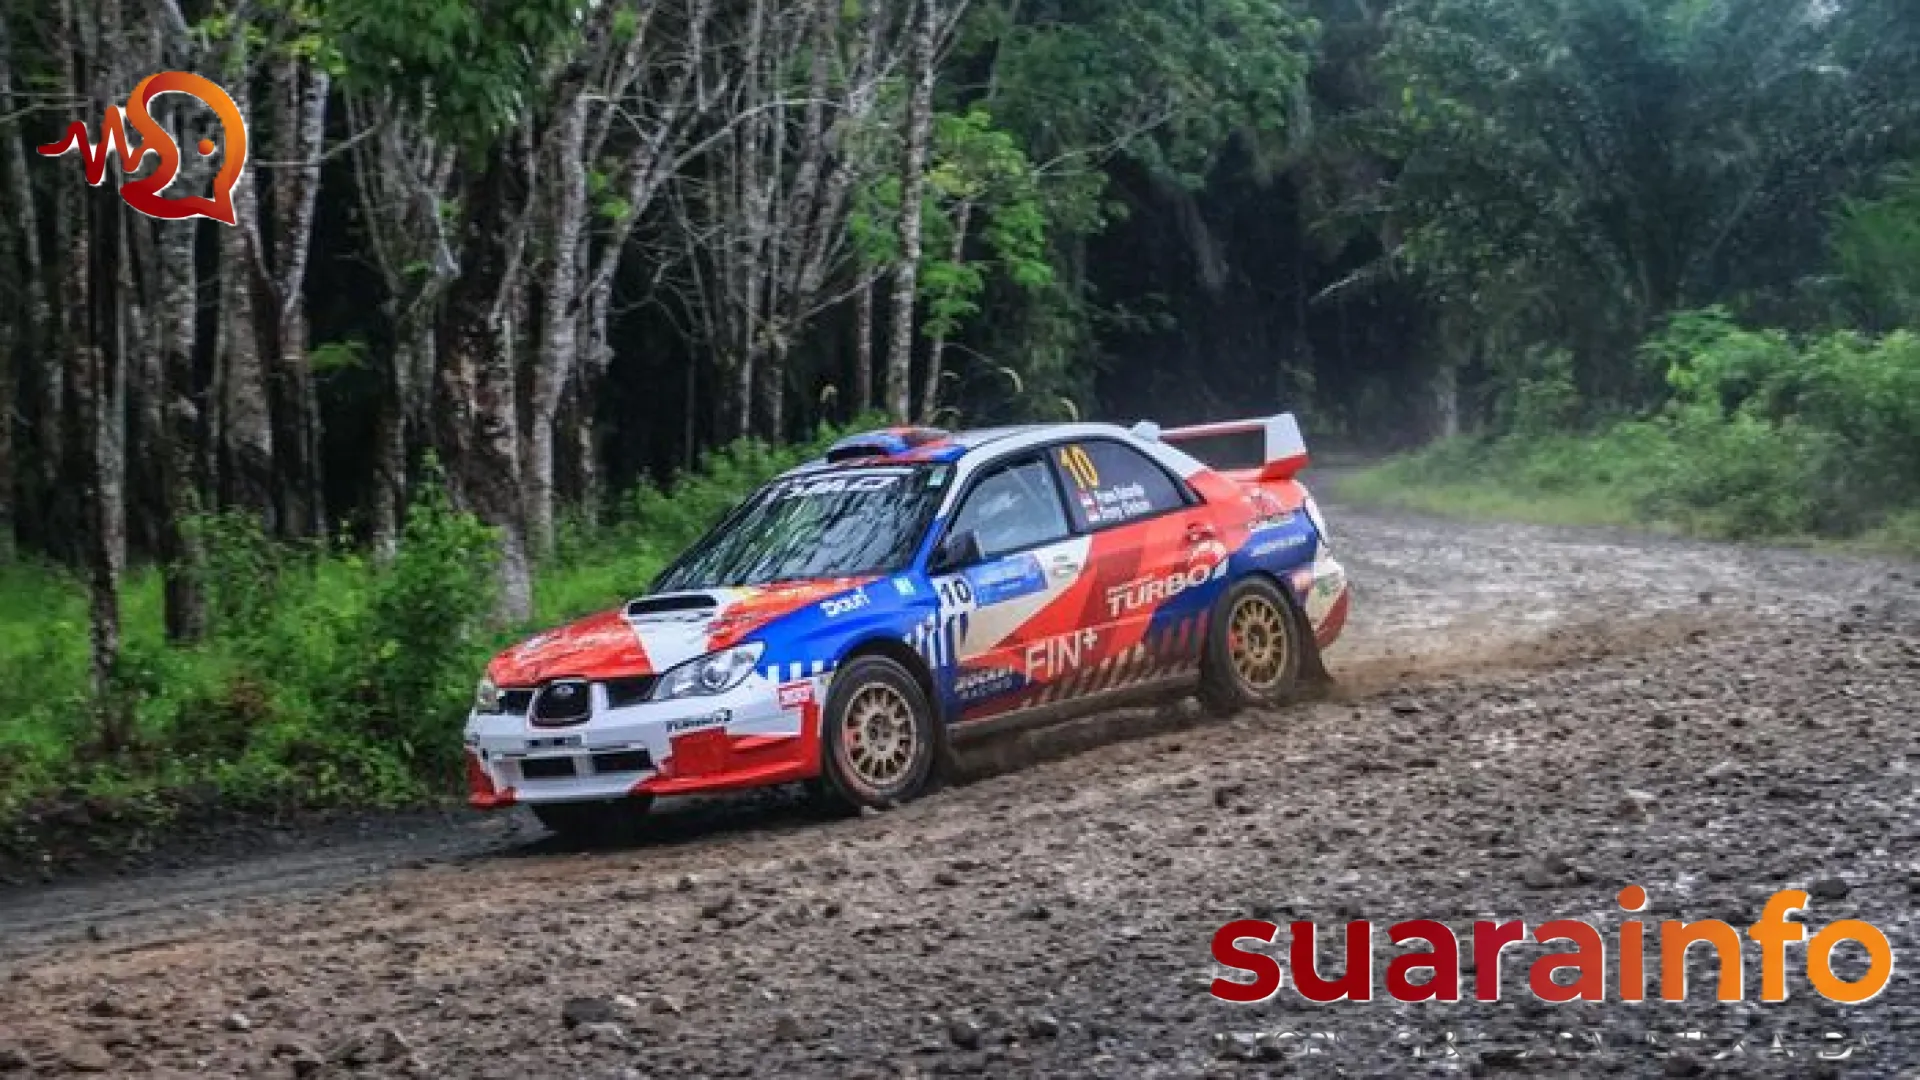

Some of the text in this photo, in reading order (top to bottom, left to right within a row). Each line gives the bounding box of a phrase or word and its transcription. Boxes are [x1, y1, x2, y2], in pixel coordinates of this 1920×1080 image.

[1060, 443, 1098, 489] 10
[941, 578, 972, 607] 10
[1106, 564, 1212, 617] TURBO
